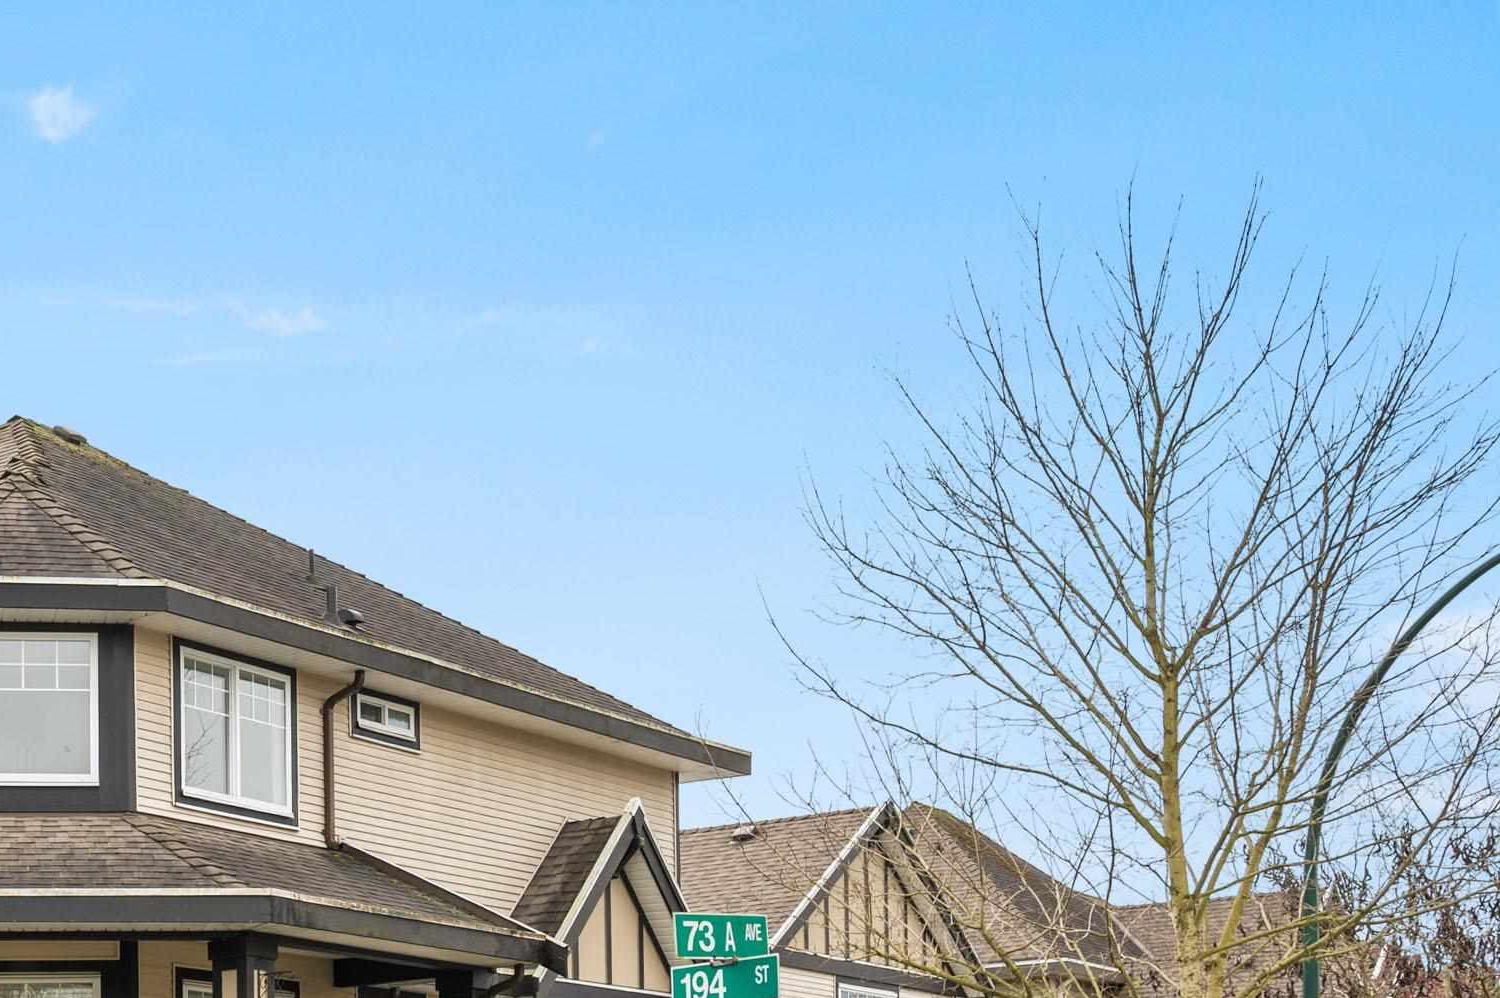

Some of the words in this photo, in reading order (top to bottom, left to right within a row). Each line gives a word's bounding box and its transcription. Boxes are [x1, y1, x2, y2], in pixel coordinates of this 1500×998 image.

[683, 920, 716, 952] 73
[725, 921, 737, 952] A
[745, 923, 763, 942] AVE
[754, 965, 770, 984] ST
